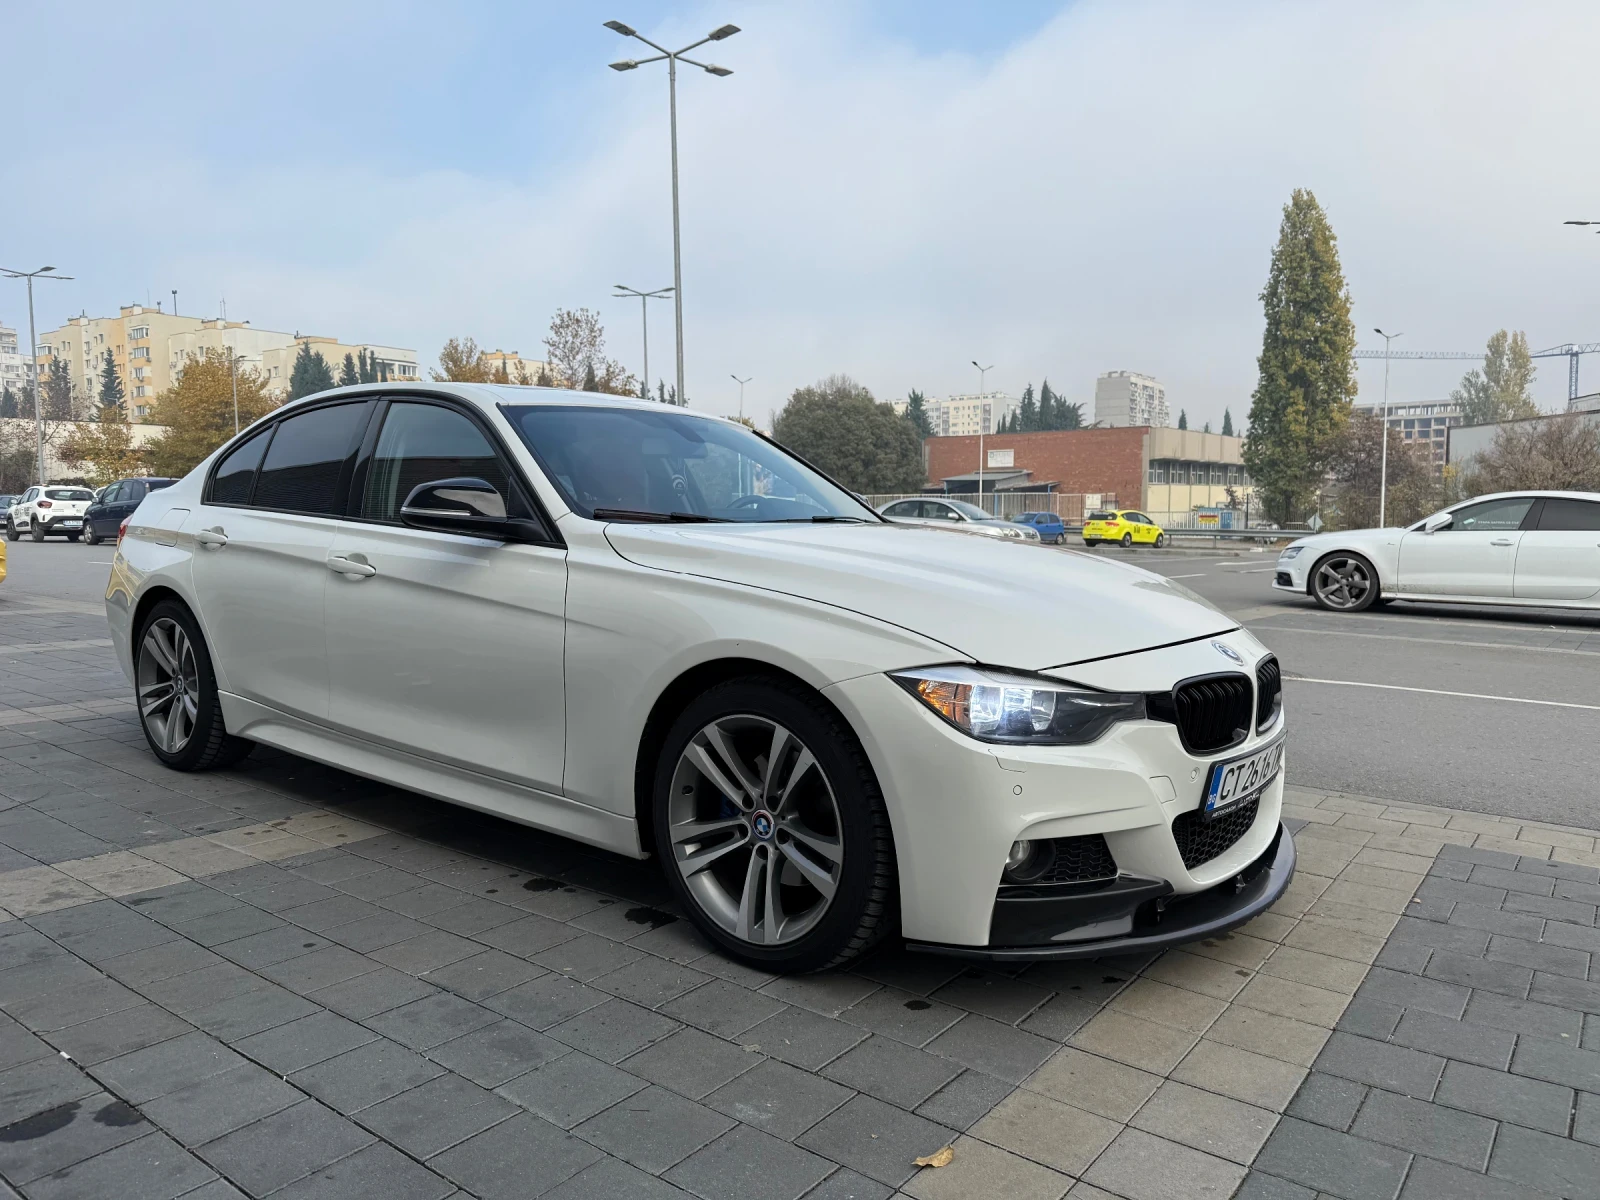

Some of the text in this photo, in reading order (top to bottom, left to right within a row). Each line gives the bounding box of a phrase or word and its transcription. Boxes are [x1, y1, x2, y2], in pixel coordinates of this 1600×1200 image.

[1221, 764, 1246, 800] CT
[1241, 748, 1274, 792] 2616
[1207, 793, 1217, 805] BG
